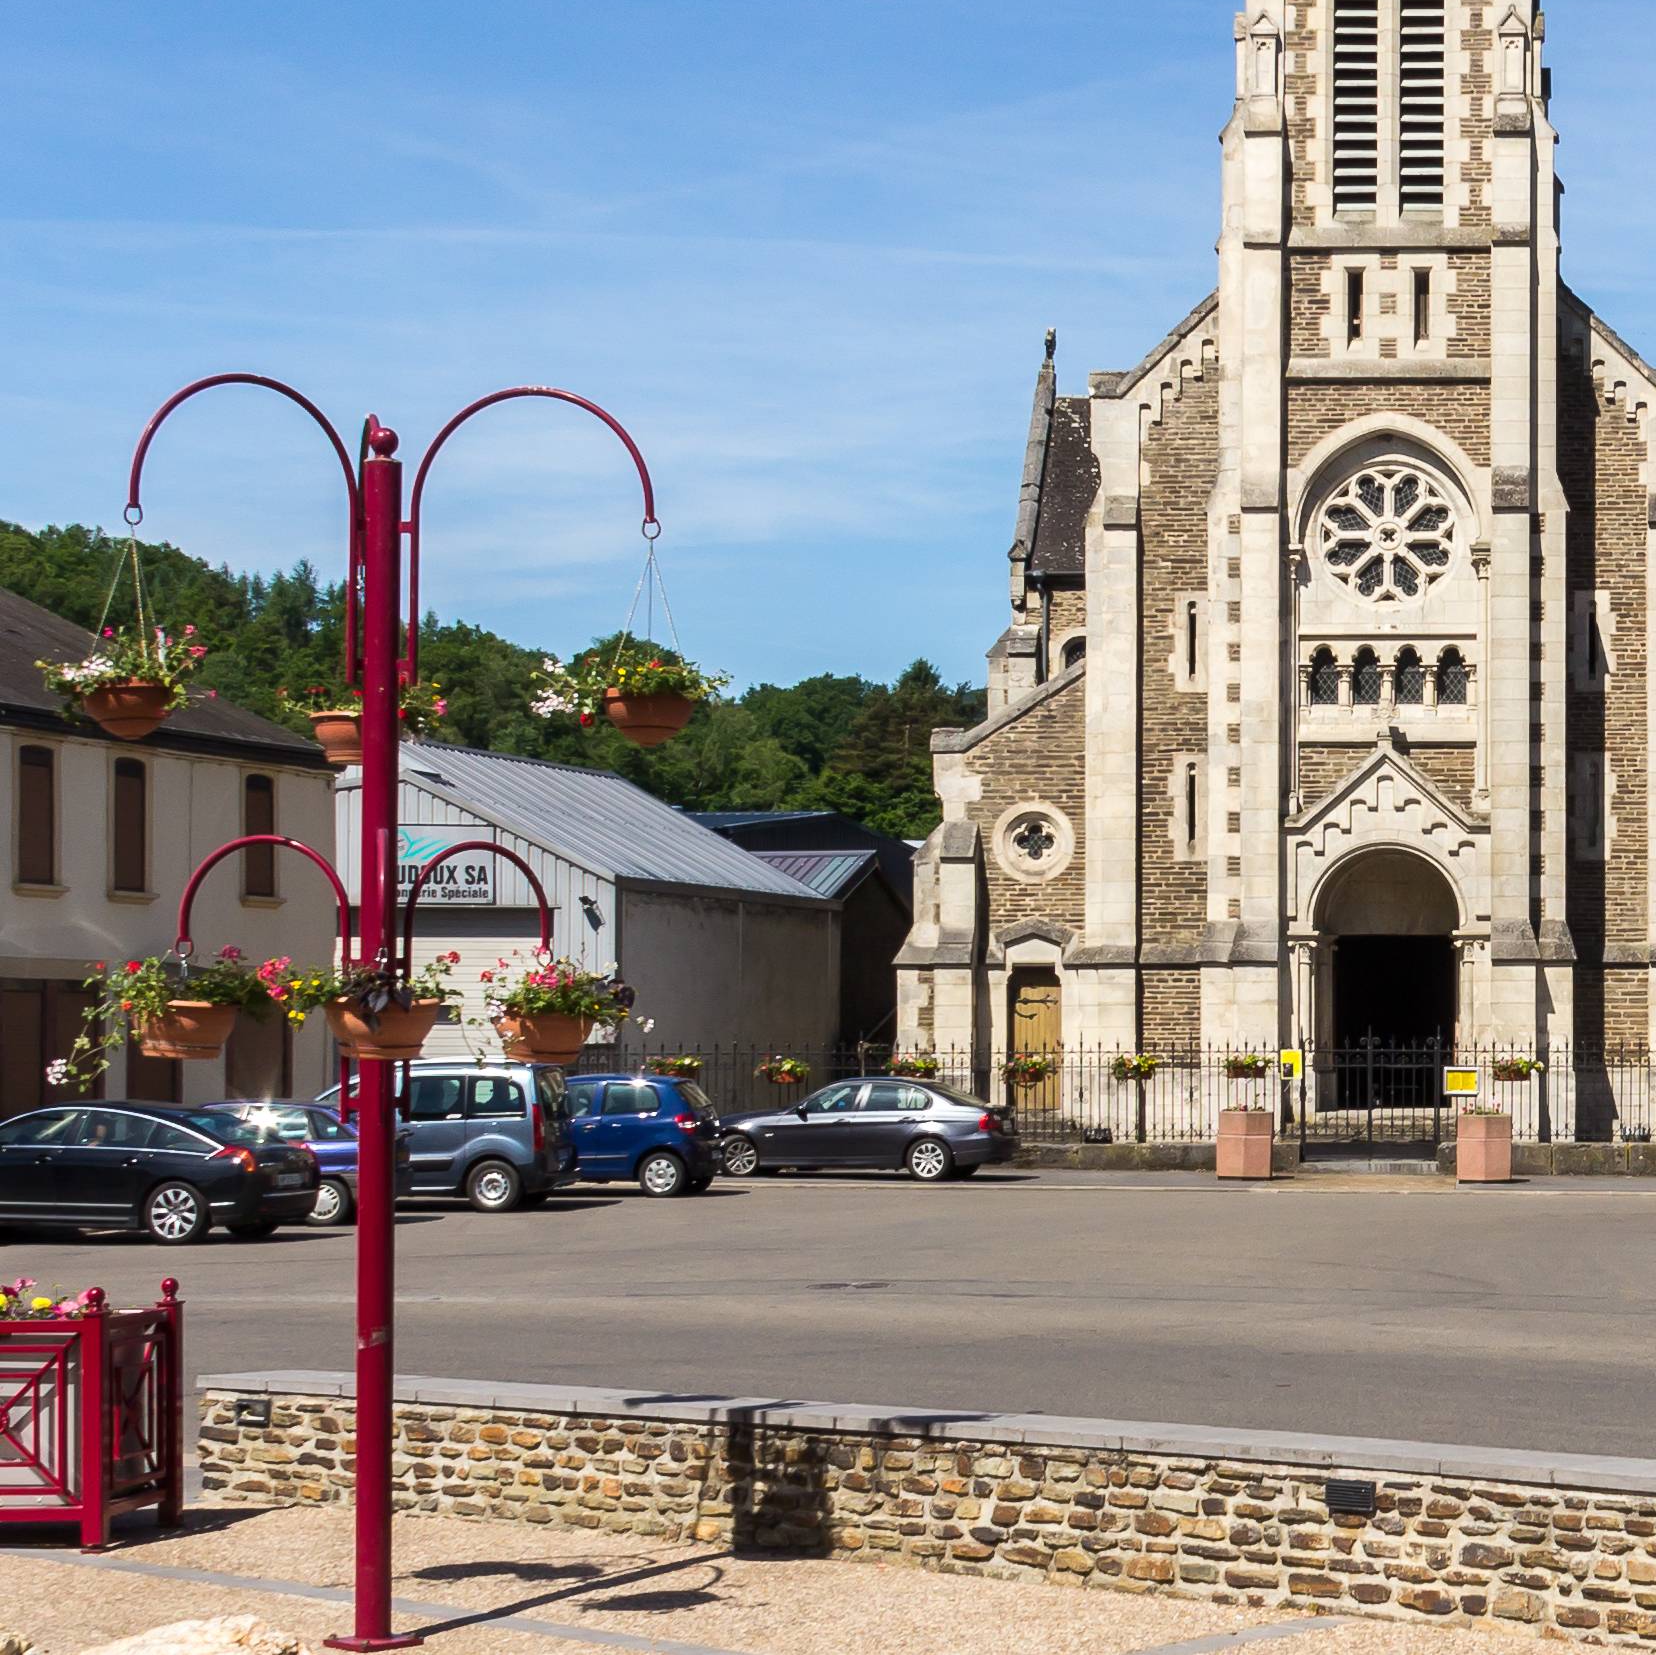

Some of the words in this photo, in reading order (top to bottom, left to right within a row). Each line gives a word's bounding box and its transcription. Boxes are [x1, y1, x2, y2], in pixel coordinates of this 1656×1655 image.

[398, 865, 458, 885] UDUX
[465, 865, 489, 885] SA
[441, 886, 489, 900] Spéciale
